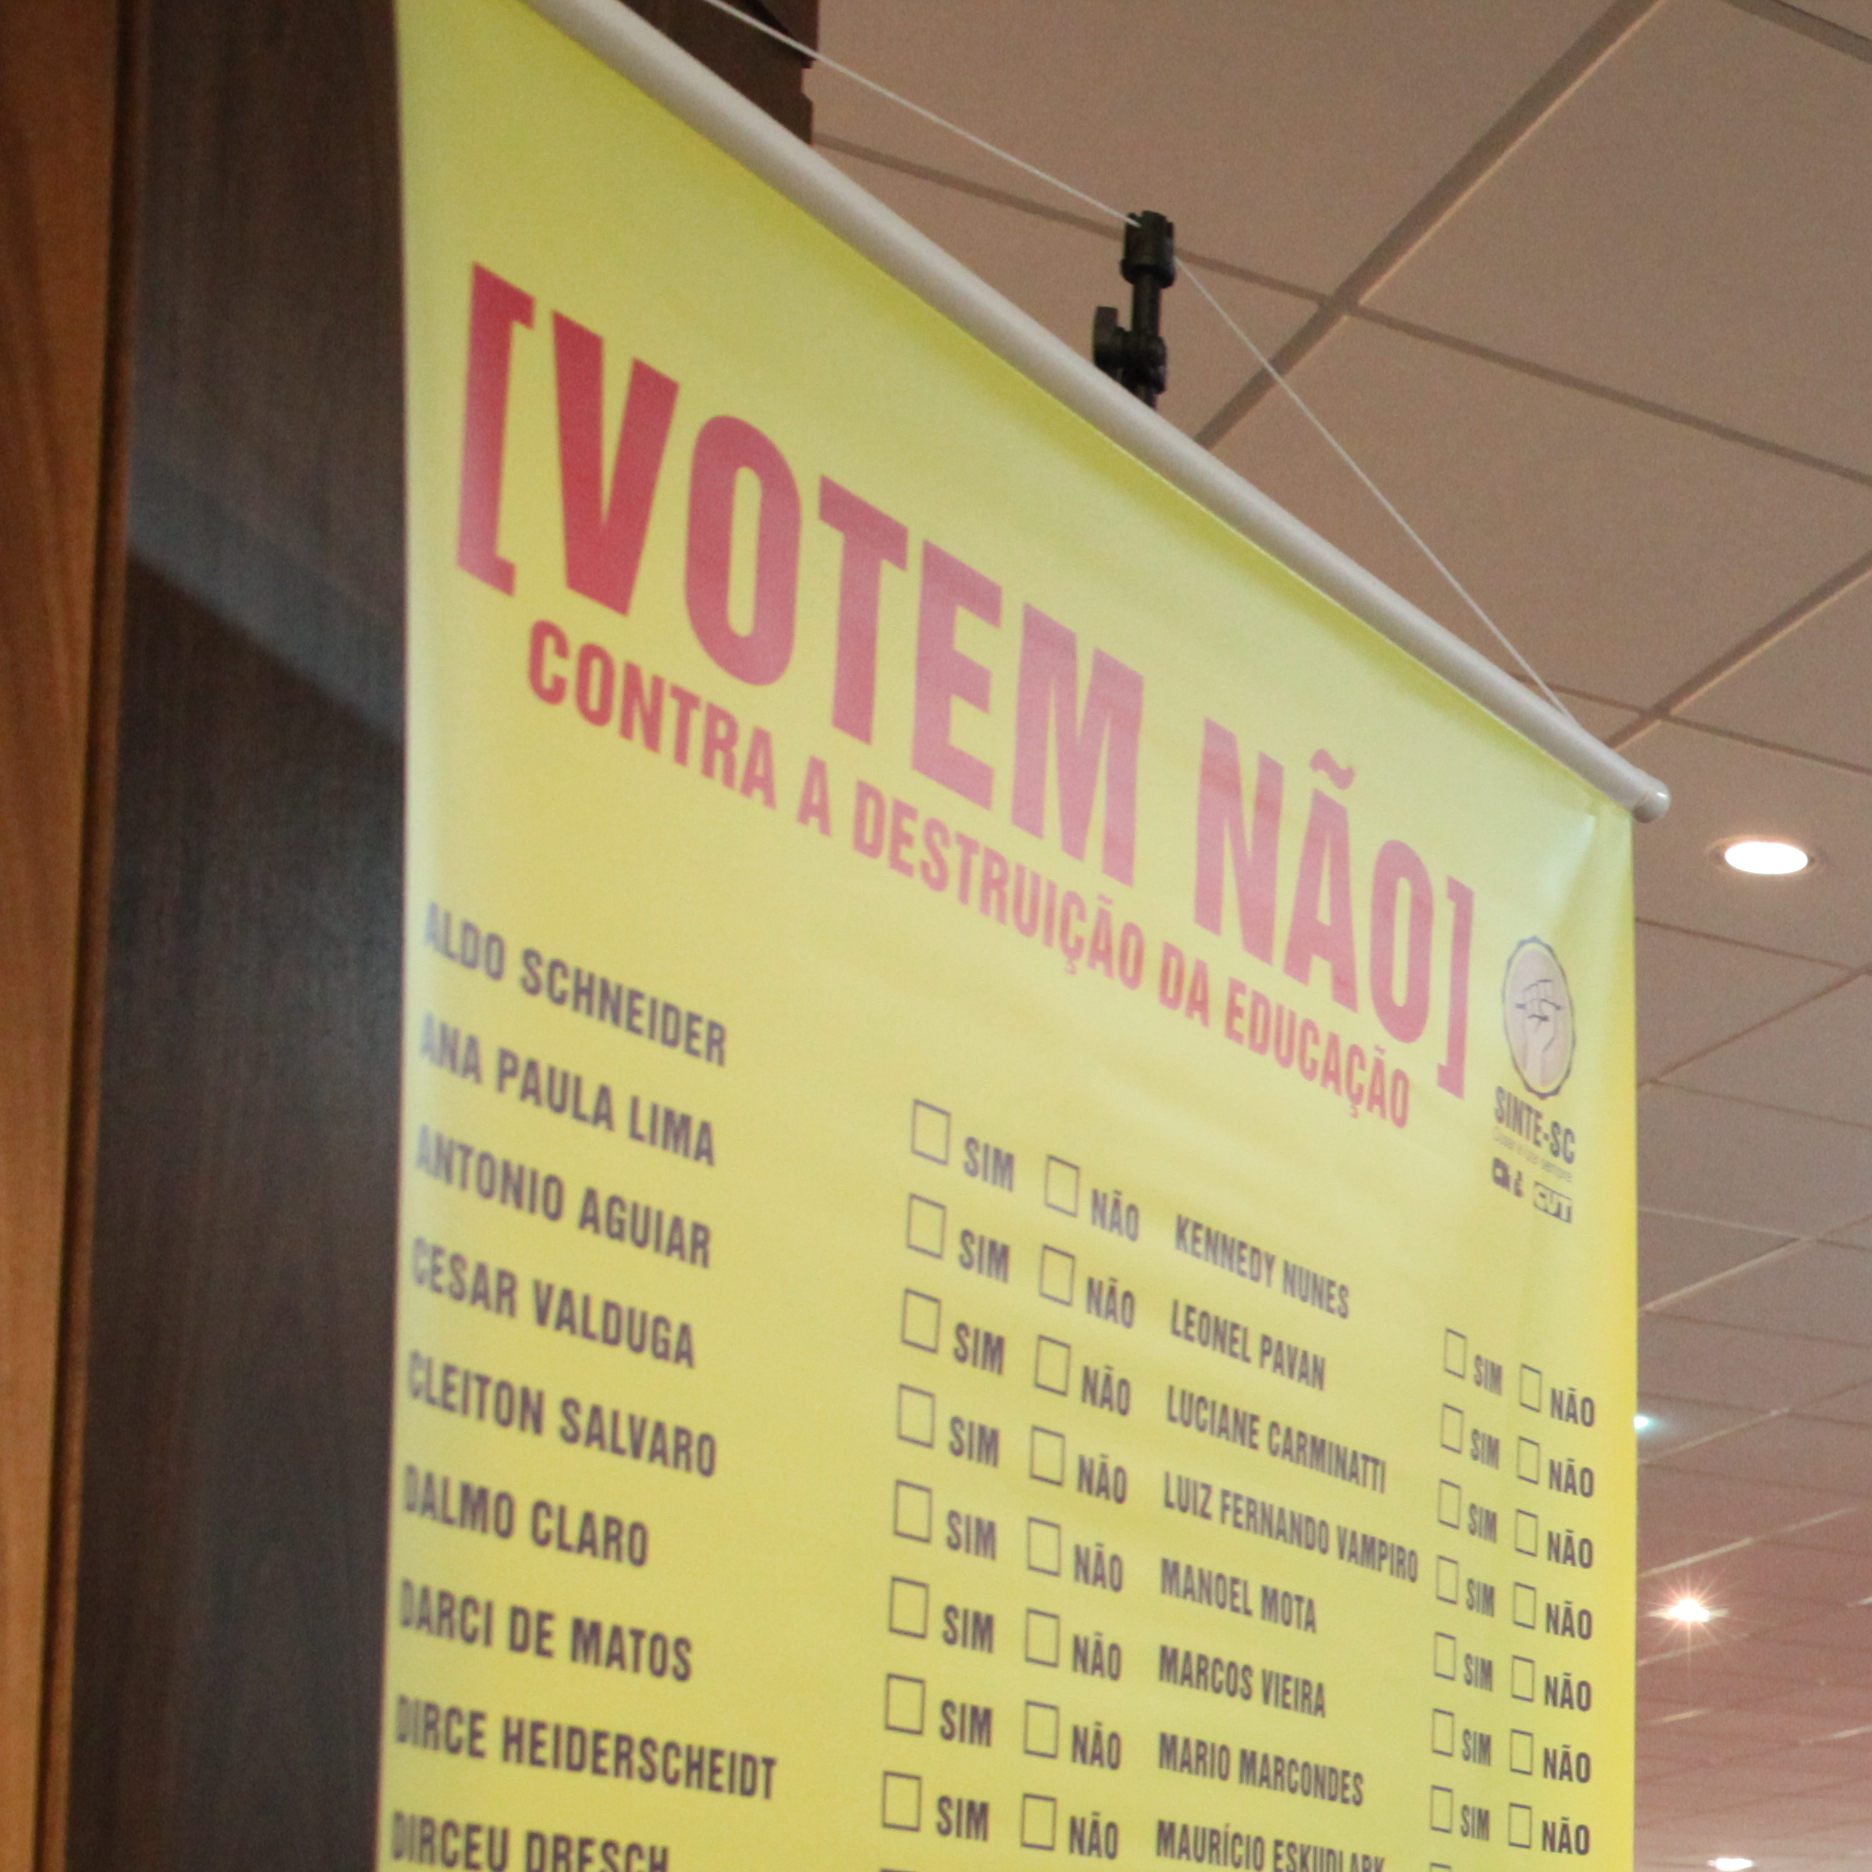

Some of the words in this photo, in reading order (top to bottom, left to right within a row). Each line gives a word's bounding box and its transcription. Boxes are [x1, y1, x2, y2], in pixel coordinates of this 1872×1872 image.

[527, 618, 777, 809] CONTRA
[797, 755, 832, 835] A
[852, 780, 1144, 988] DESTRUIÇÃO
[1159, 942, 1211, 1027] DA
[1225, 979, 1410, 1129] EDUCAÇÃO
[426, 903, 507, 982] ALDO
[521, 948, 728, 1068] SCHNEIDER
[421, 1013, 483, 1084] ANA
[497, 1048, 616, 1132] PAULA
[630, 1096, 716, 1167] LIMA
[1495, 1085, 1575, 1165] SINTE-SC
[415, 1125, 566, 1222] ANTONIO
[579, 1187, 712, 1269] AGUIAR
[964, 1136, 1015, 1191] SIM
[1091, 1189, 1139, 1241] NÃO
[412, 1238, 519, 1318] CESAR
[534, 1279, 696, 1369] VALDUGA
[1176, 1214, 1276, 1286] KENNEDY
[1283, 1261, 1349, 1319] NUNES
[953, 1322, 1006, 1375] SIM
[1081, 1365, 1131, 1417] NÃO
[1171, 1299, 1252, 1363] LEONEL
[1259, 1334, 1326, 1391] PAVAN
[1474, 1355, 1503, 1395] SIM
[1550, 1388, 1596, 1428] NÃO
[409, 1351, 546, 1436] CLEITON
[560, 1397, 718, 1478] SALVARO
[1167, 1385, 1261, 1451] LUCIANE
[1268, 1421, 1386, 1493] CARMINATTI
[404, 1465, 517, 1540] DALMO
[531, 1499, 650, 1568] CLARO
[946, 1510, 997, 1560] SIM
[1074, 1543, 1124, 1593] NÃO
[1164, 1472, 1212, 1520] LUIZ
[1220, 1489, 1330, 1555] FERNANDO
[1337, 1526, 1418, 1583] VAMPIRO
[1468, 1503, 1498, 1543] SIM
[1547, 1529, 1594, 1569] NÃO
[400, 1579, 495, 1648] DARCI
[509, 1605, 557, 1659] DE
[571, 1616, 694, 1683] MATOS
[1161, 1558, 1253, 1617] MANOEL
[1261, 1585, 1317, 1633] MOTA
[1158, 1644, 1254, 1701] MARCOS
[1261, 1669, 1326, 1718] VIEIRA
[397, 1695, 488, 1760] DIRCE
[502, 1715, 778, 1800] HEIDERSCHEIDT
[939, 1699, 993, 1748] SIM
[1071, 1721, 1122, 1771] NÃO
[1158, 1732, 1231, 1782] MARIO
[1238, 1748, 1364, 1807] MARCONDES
[1462, 1728, 1492, 1766] SIM
[1543, 1744, 1592, 1784] NÃO
[1156, 1820, 1265, 1872] MAURÍCIO
